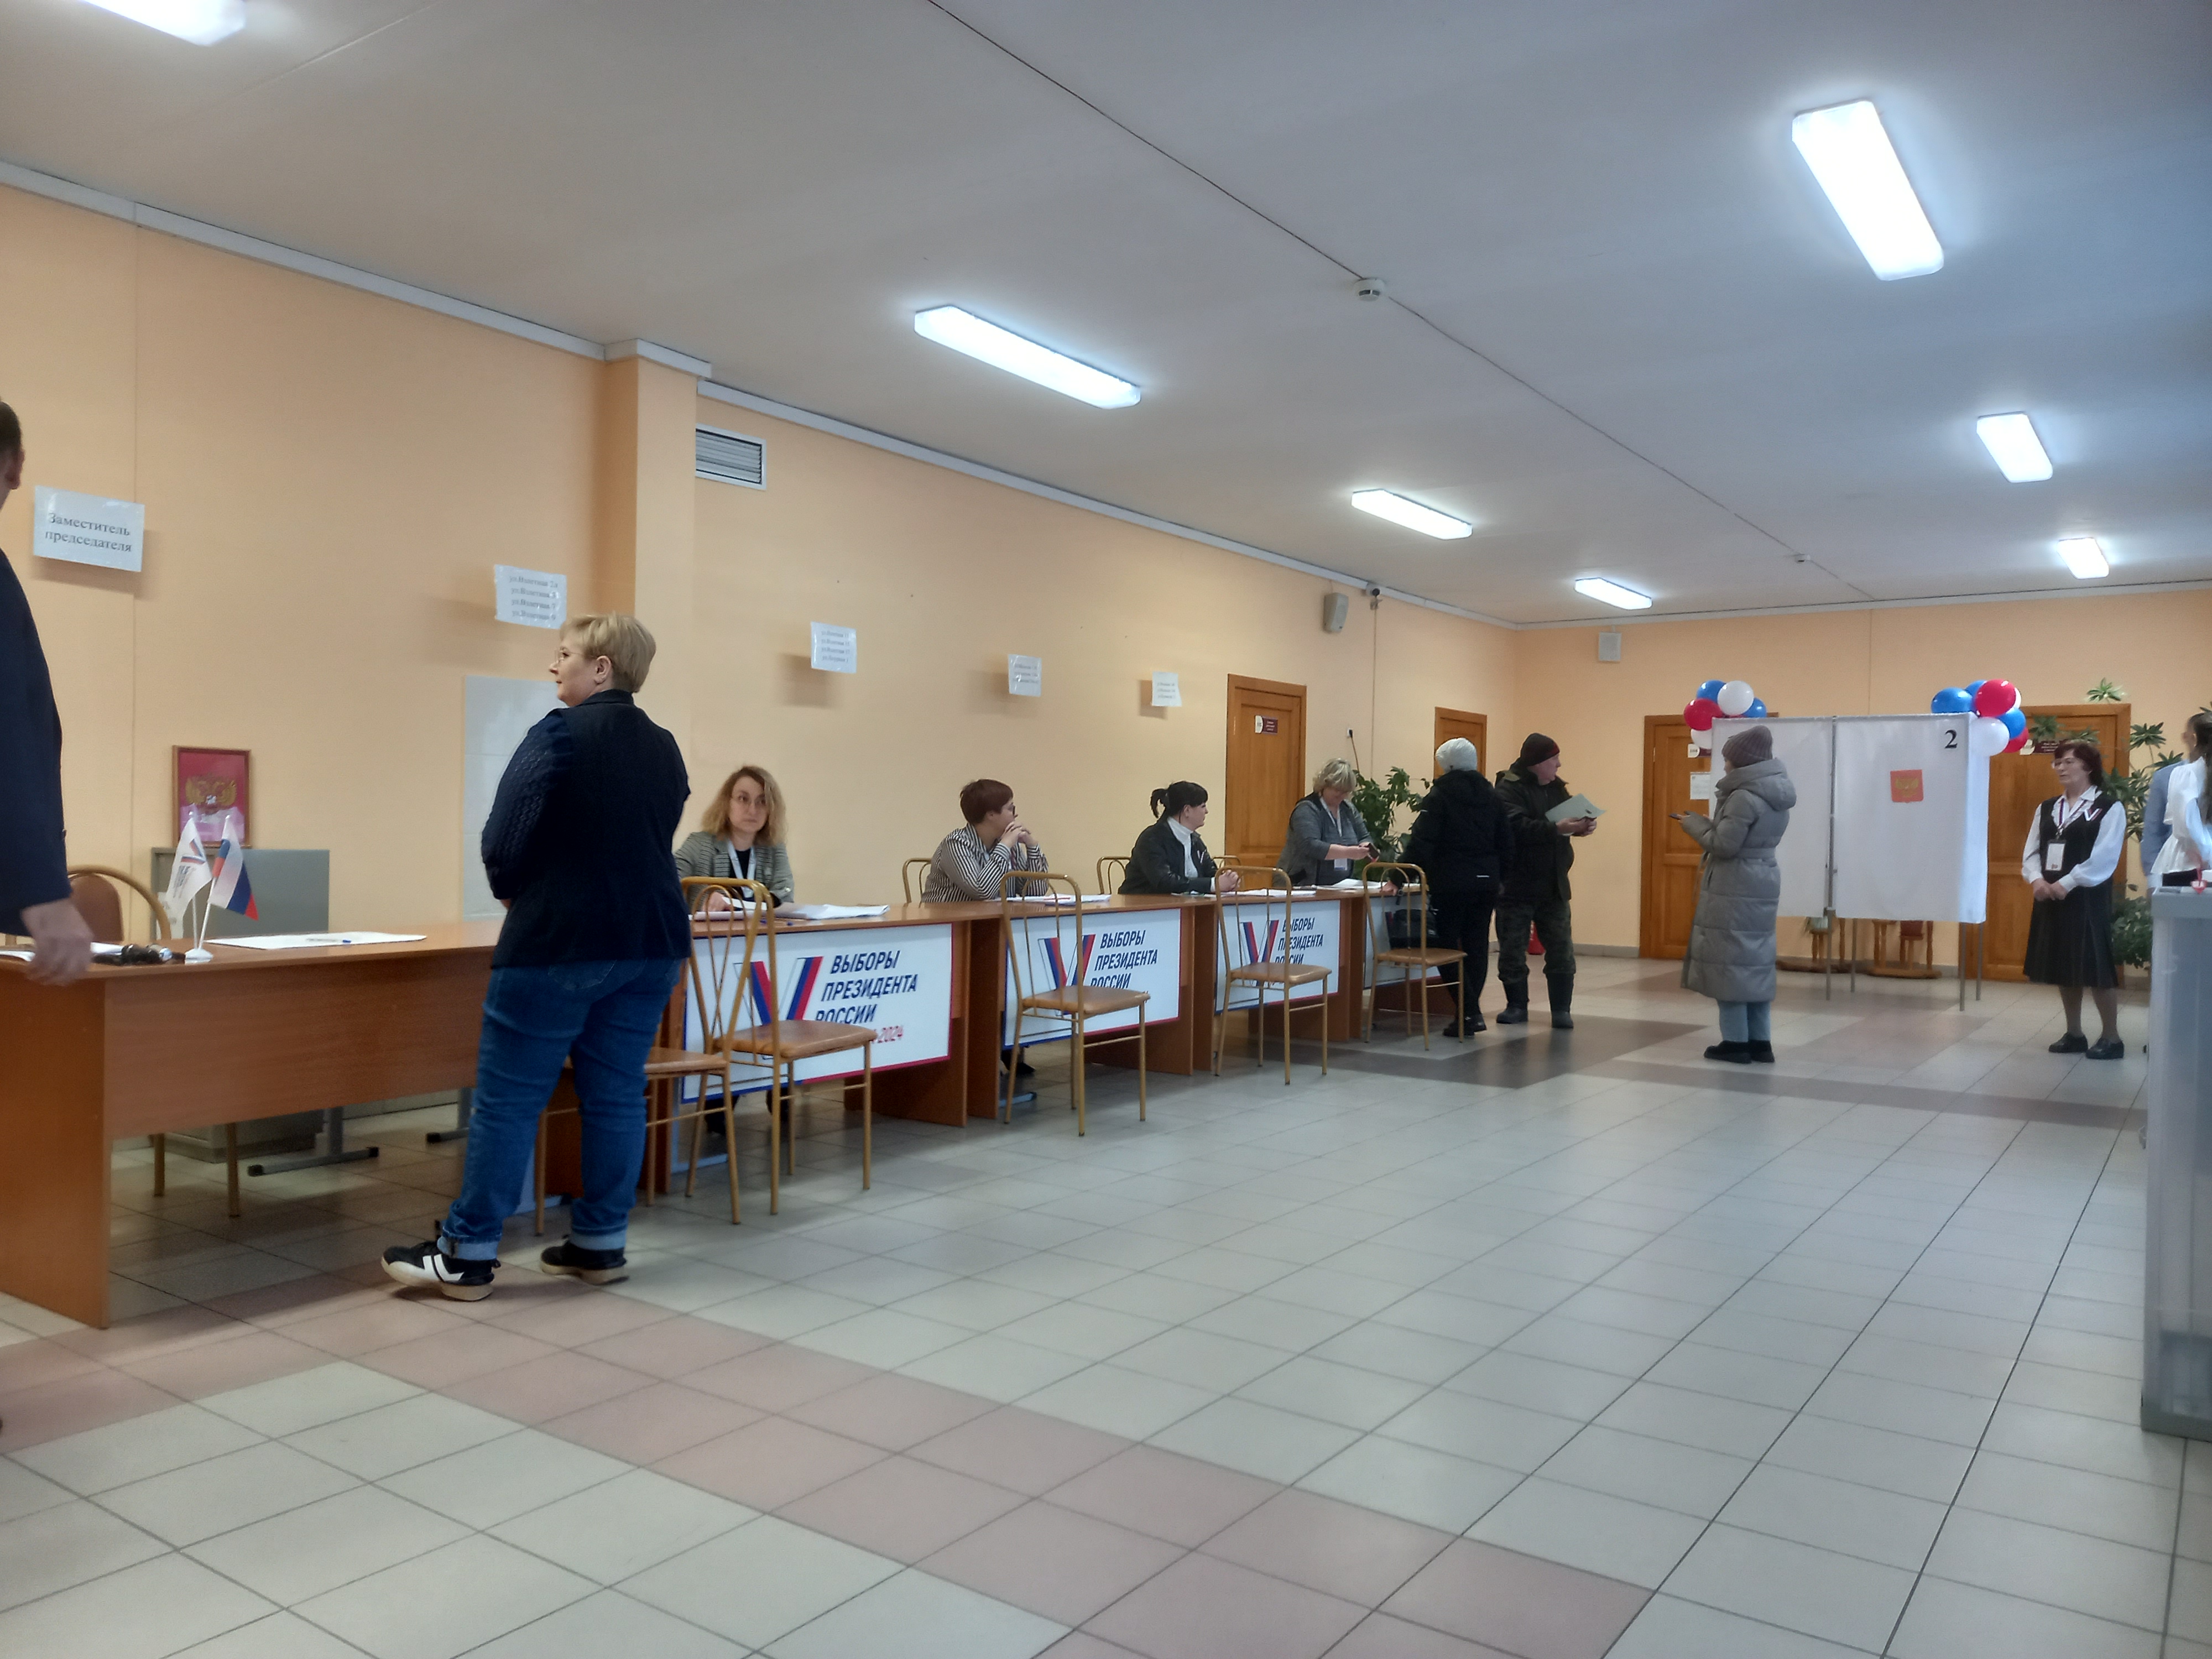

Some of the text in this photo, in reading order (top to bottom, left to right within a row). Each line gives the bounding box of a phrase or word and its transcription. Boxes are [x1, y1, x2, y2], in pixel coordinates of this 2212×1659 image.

[48, 512, 130, 536] Заместитель
[45, 530, 132, 552] председателя
[1944, 729, 1958, 749] 2
[1100, 930, 1146, 948] ВЫБОРЫ
[1277, 934, 1323, 951] ПЕЗИДЕНТА
[831, 950, 900, 974] ВЫБОРЫ
[1094, 950, 1157, 971] ПРЕЗИДЕНТА
[821, 974, 918, 1002] ПРЕЗИДЕНТА
